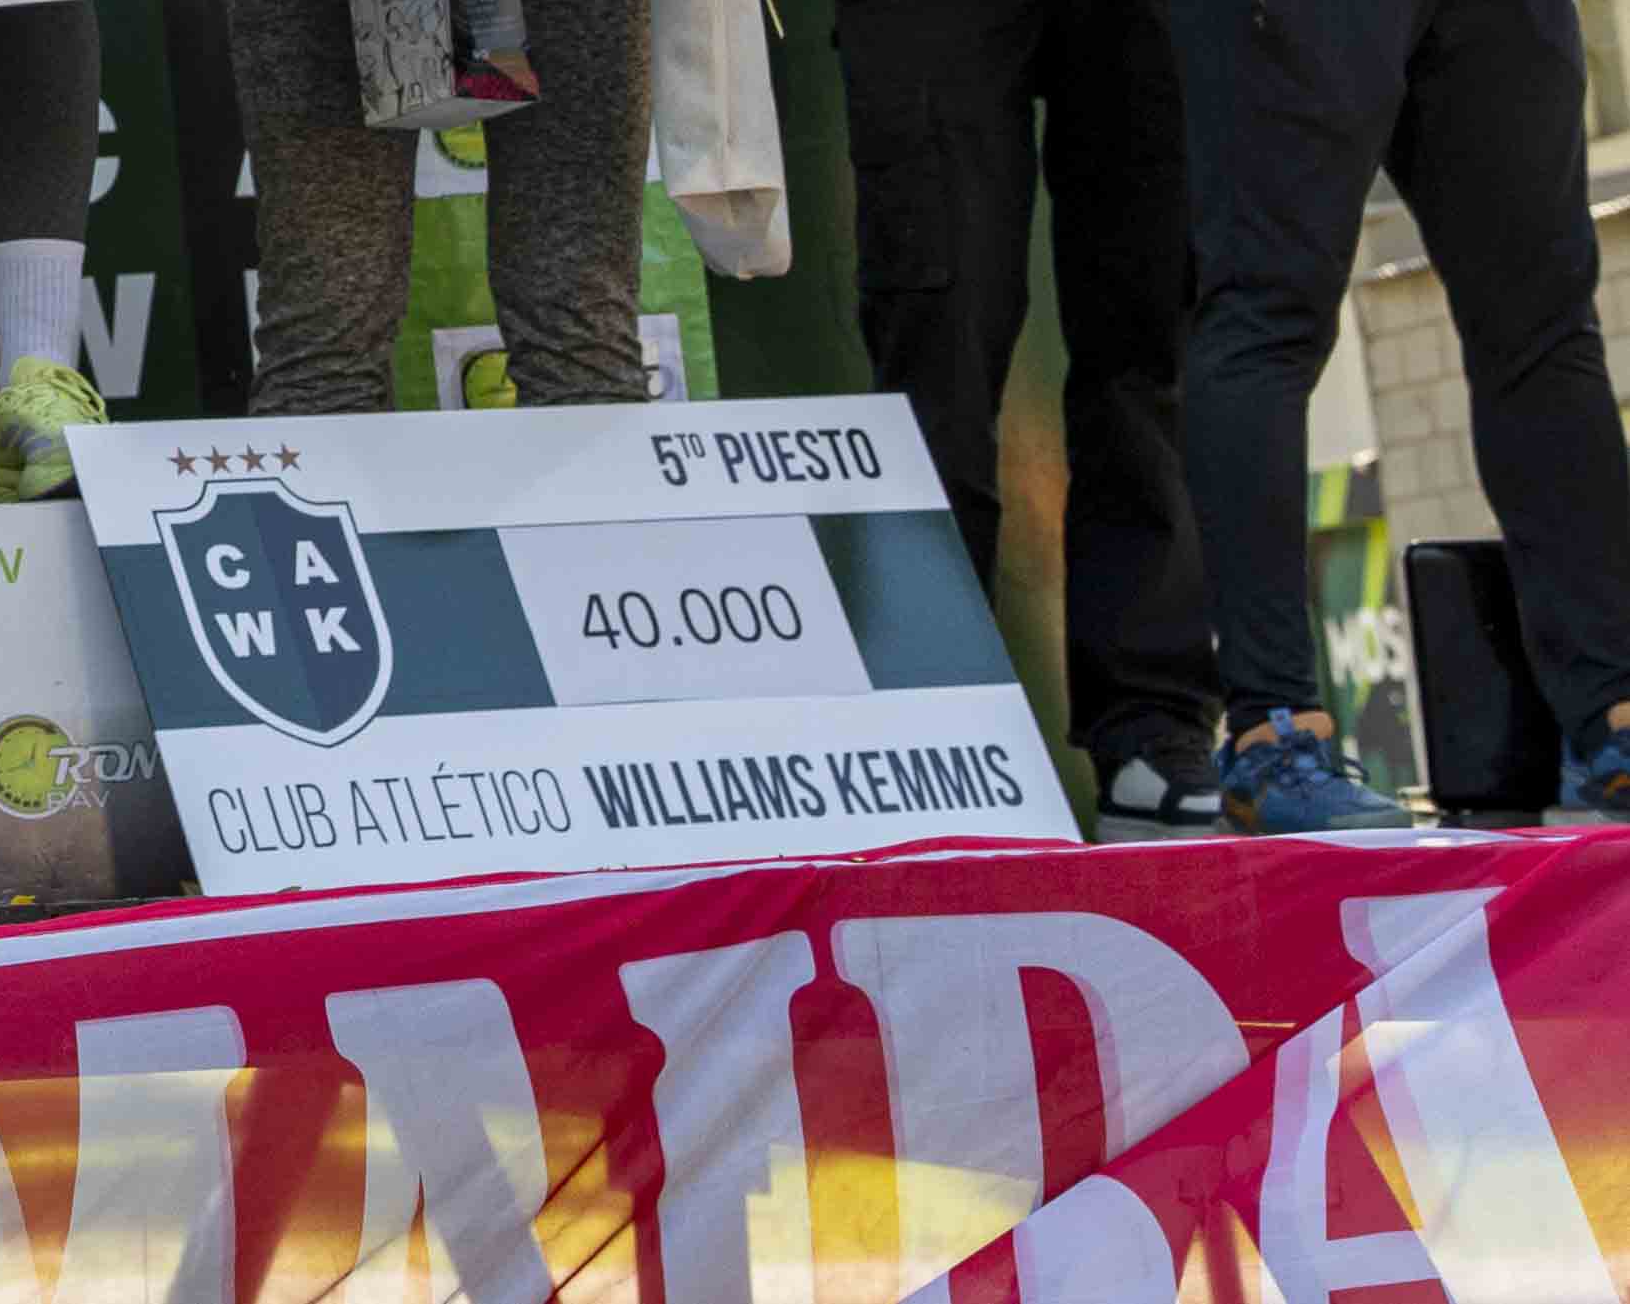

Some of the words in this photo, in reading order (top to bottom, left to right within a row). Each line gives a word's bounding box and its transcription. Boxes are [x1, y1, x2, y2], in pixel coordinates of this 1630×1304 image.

[715, 427, 882, 486] PUESTO
[205, 544, 250, 591] C
[293, 538, 338, 585] A
[213, 610, 277, 659] W
[306, 606, 363, 653] K
[580, 584, 802, 651] 40.000
[207, 782, 338, 855] CLUB
[348, 761, 573, 846] ATLÉTICO
[582, 754, 825, 830] WILLIAMS
[827, 744, 1025, 816] KEMMIS
